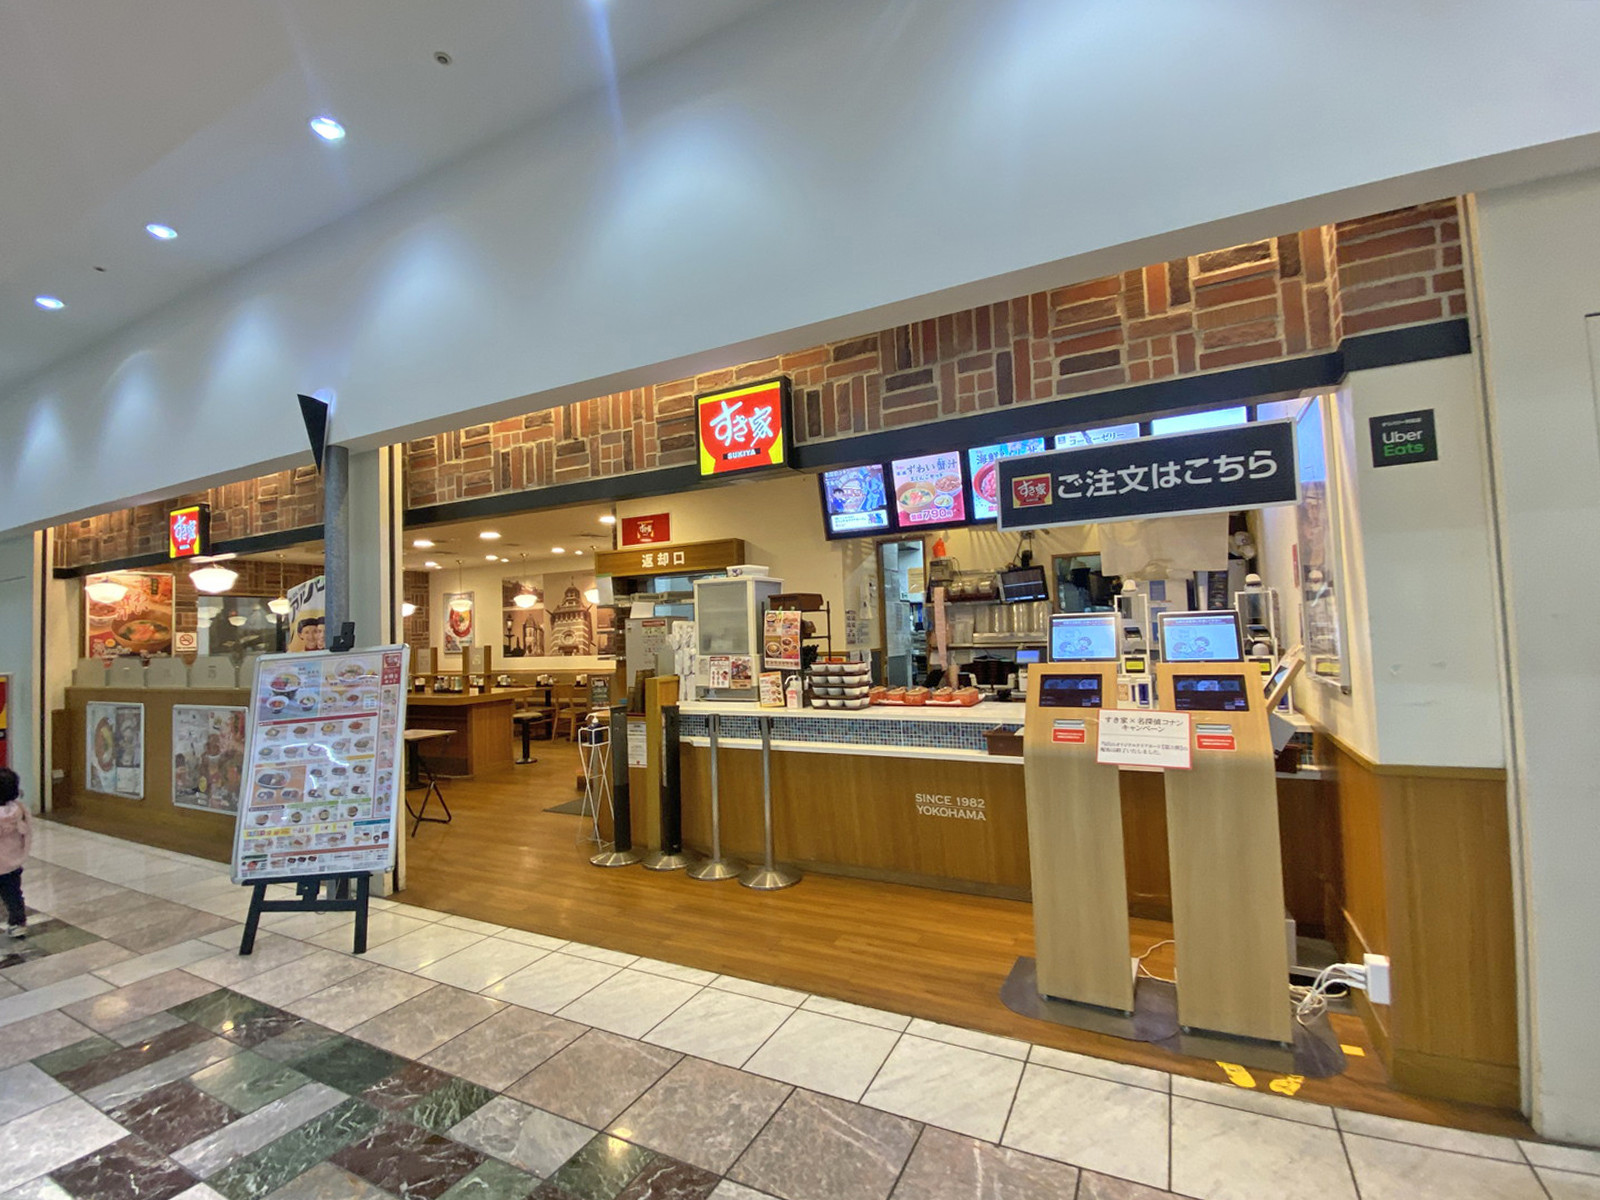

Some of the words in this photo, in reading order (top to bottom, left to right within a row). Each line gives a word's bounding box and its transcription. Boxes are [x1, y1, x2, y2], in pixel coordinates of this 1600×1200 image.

[709, 401, 774, 447] すき家
[1382, 430, 1423, 444] Uber
[1384, 443, 1425, 457] Eats
[1057, 450, 1278, 498] ご注文はこちら
[1018, 480, 1048, 498] すき家
[641, 551, 685, 568] 返却口
[1121, 724, 1166, 733] キャンペーン
[915, 793, 952, 805] SINCE
[956, 796, 986, 808] 1982
[916, 804, 987, 821] YOKOHAMA
